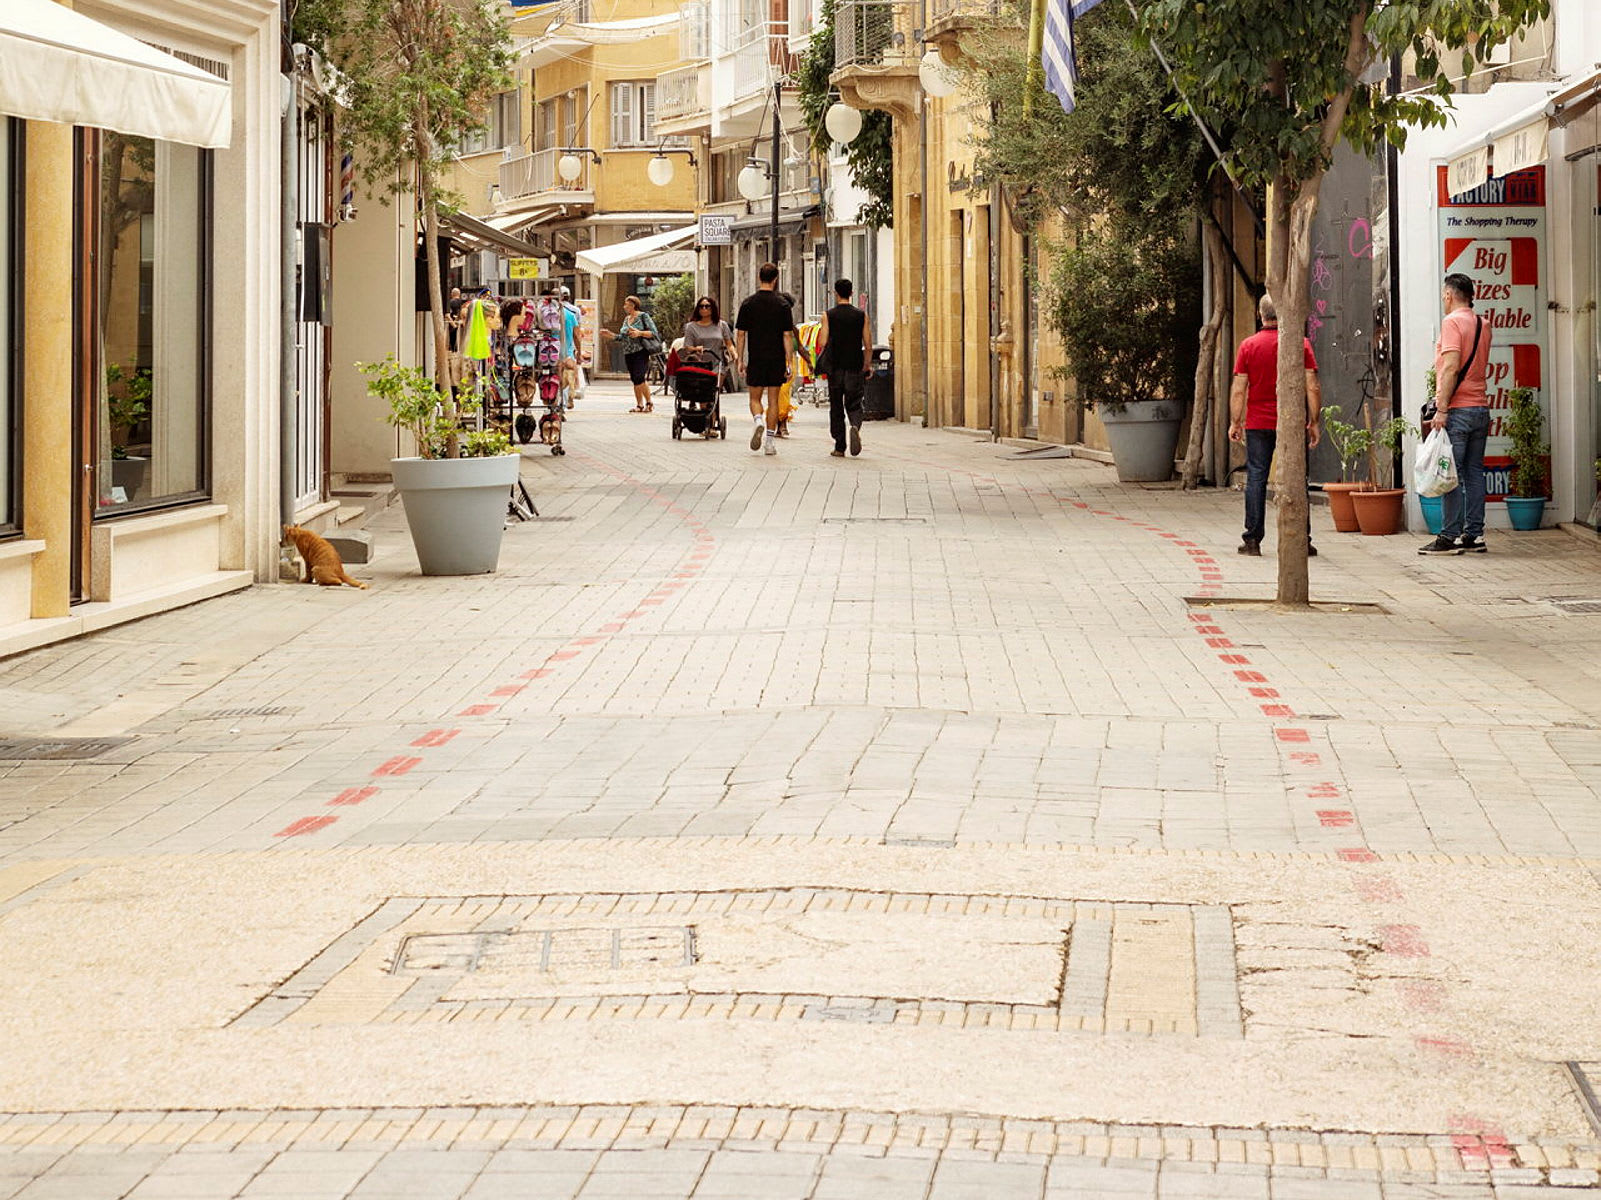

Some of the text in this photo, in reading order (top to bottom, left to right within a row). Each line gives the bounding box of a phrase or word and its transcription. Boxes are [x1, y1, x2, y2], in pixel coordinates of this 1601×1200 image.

[1450, 179, 1505, 204] CTORY
[704, 218, 725, 227] PASTA
[1447, 216, 1538, 228] The Shopping Therapy
[1474, 247, 1507, 275] Big
[1471, 279, 1511, 300] izes
[1485, 361, 1509, 385] op
